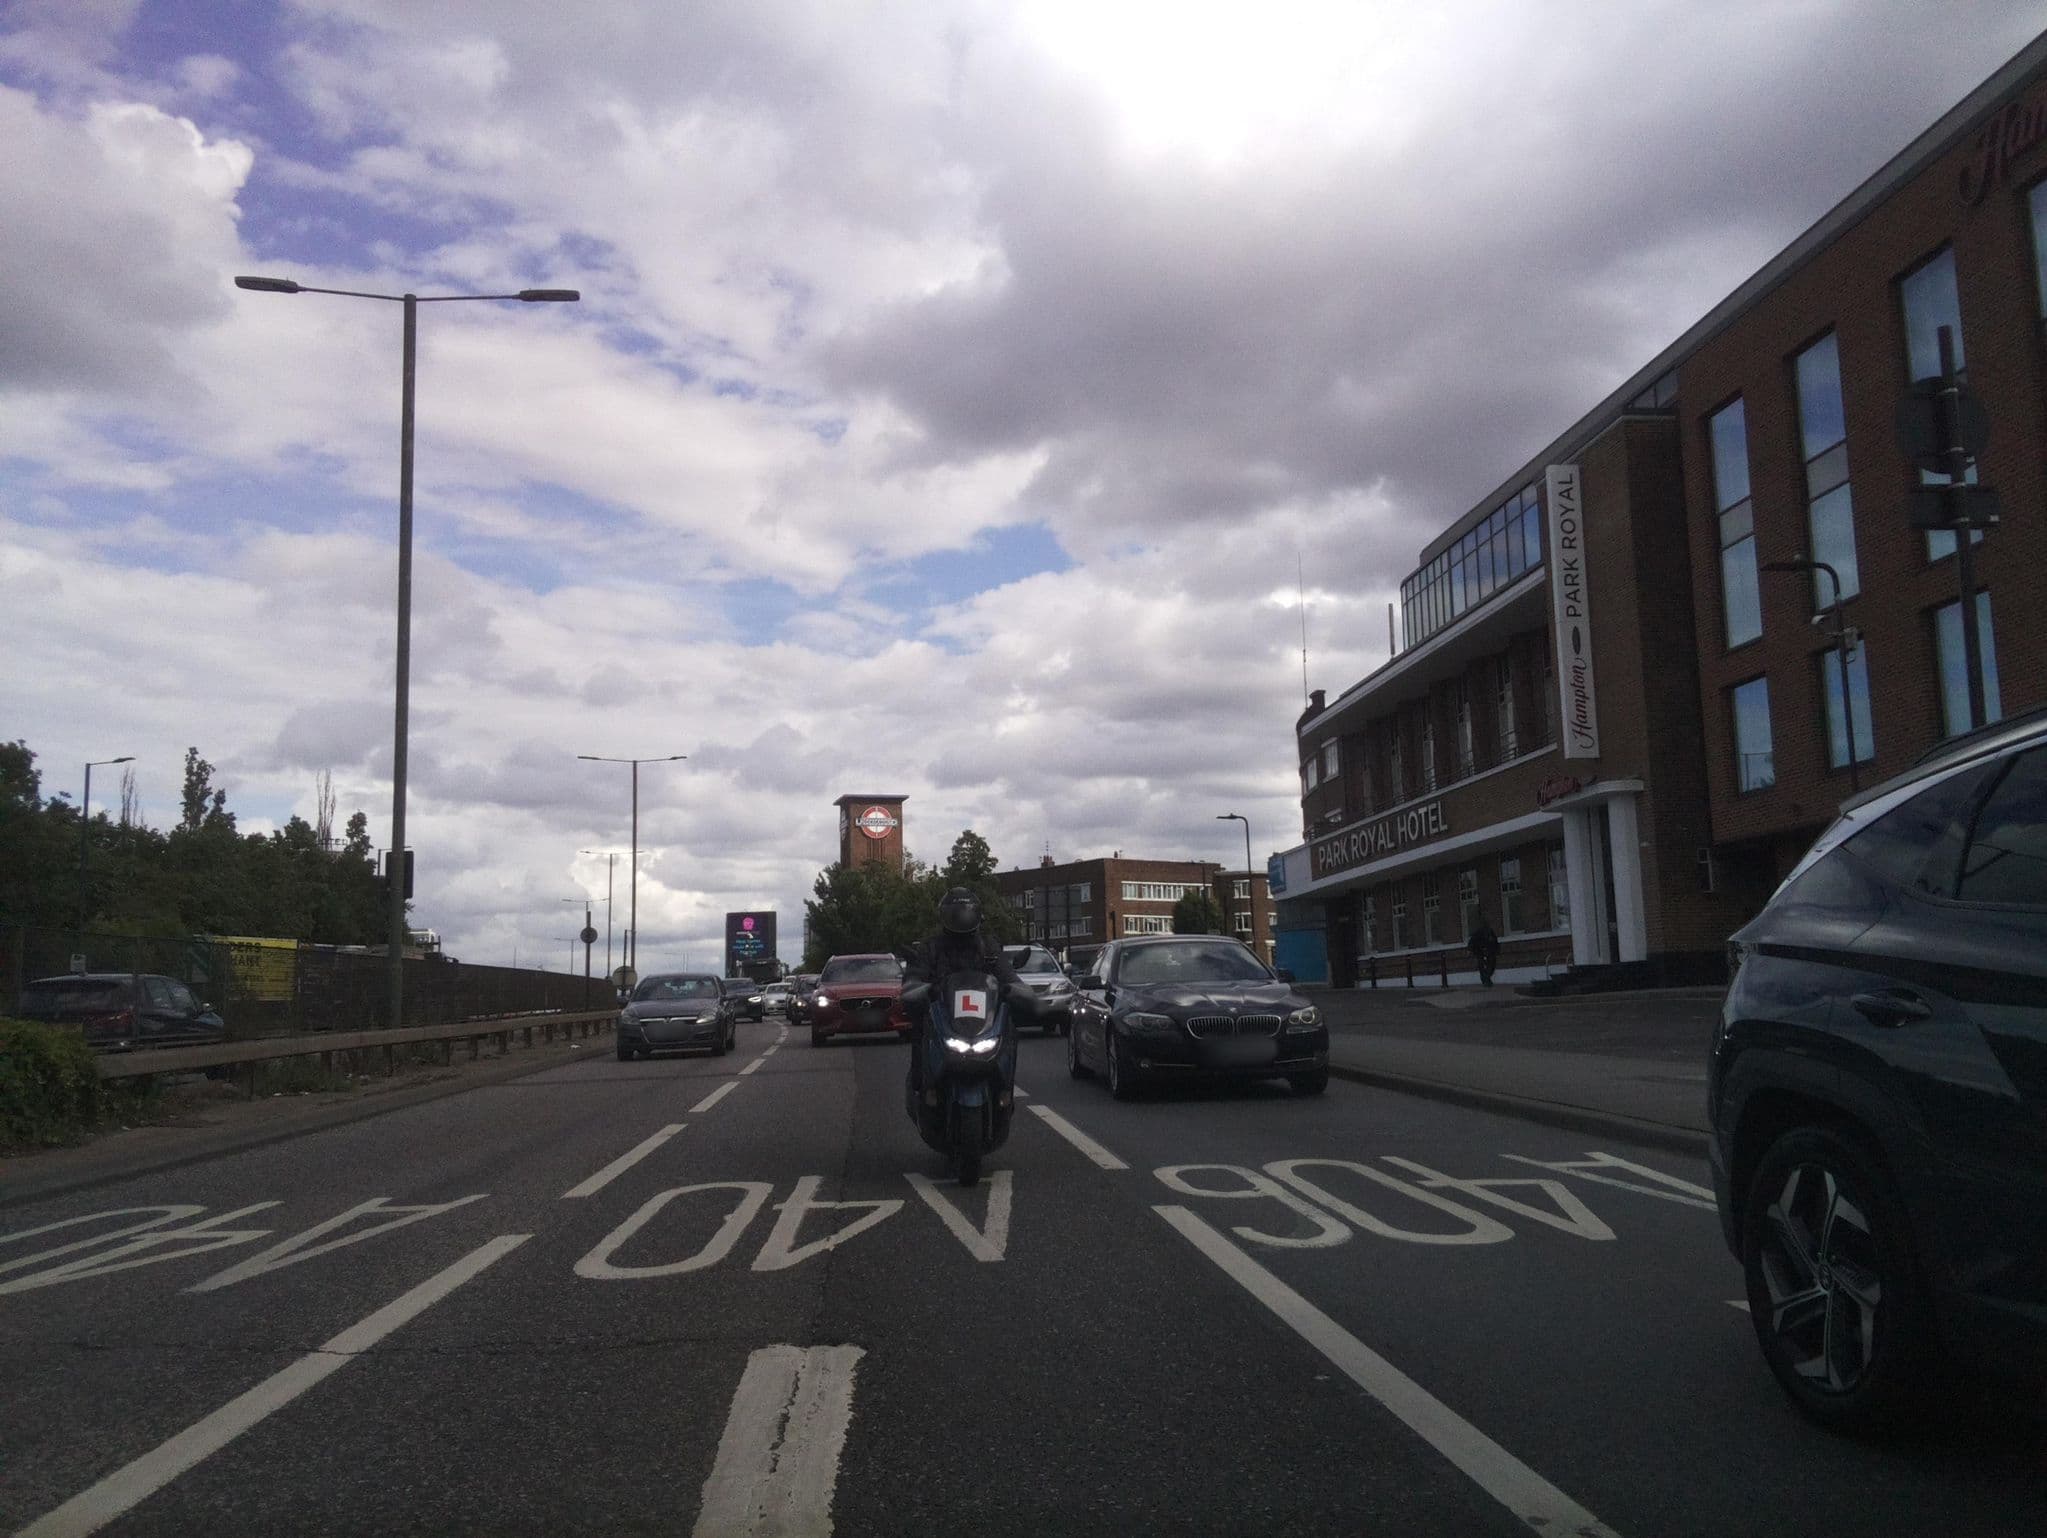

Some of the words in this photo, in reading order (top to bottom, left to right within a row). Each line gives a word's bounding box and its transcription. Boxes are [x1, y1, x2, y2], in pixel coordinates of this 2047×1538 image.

[1557, 472, 1578, 550] ROYAL
[1562, 556, 1581, 618] PARK
[1569, 656, 1596, 749] Hampton
[1318, 837, 1350, 872] PARK
[1350, 820, 1395, 860] ROYAL
[1397, 800, 1449, 843] HOTEL
[962, 995, 978, 1012] L
[573, 1170, 1014, 1280] A40
